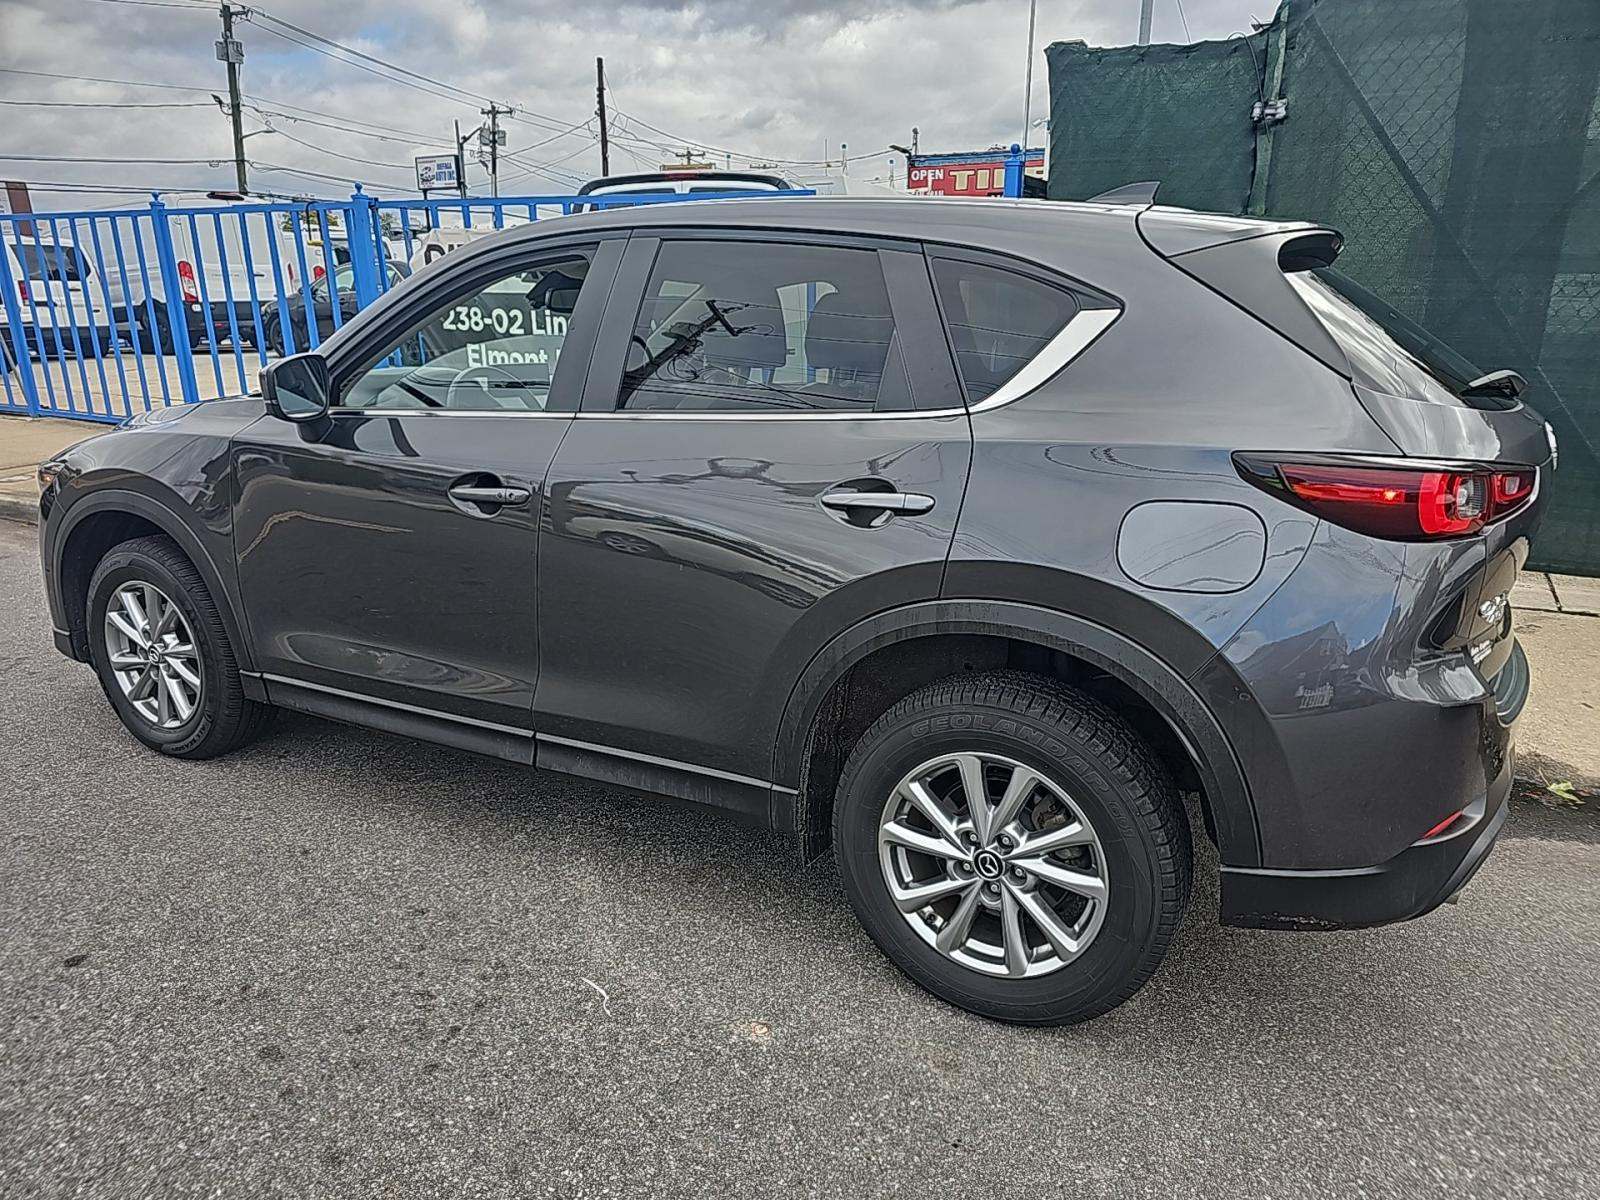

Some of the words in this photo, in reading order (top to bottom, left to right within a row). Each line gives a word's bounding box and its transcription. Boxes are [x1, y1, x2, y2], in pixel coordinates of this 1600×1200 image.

[911, 169, 944, 181] OPEN
[443, 306, 524, 335] 238-02
[531, 309, 570, 336] Lin
[466, 343, 548, 368] Elmont
[911, 714, 1110, 793] GEOLANDAR
